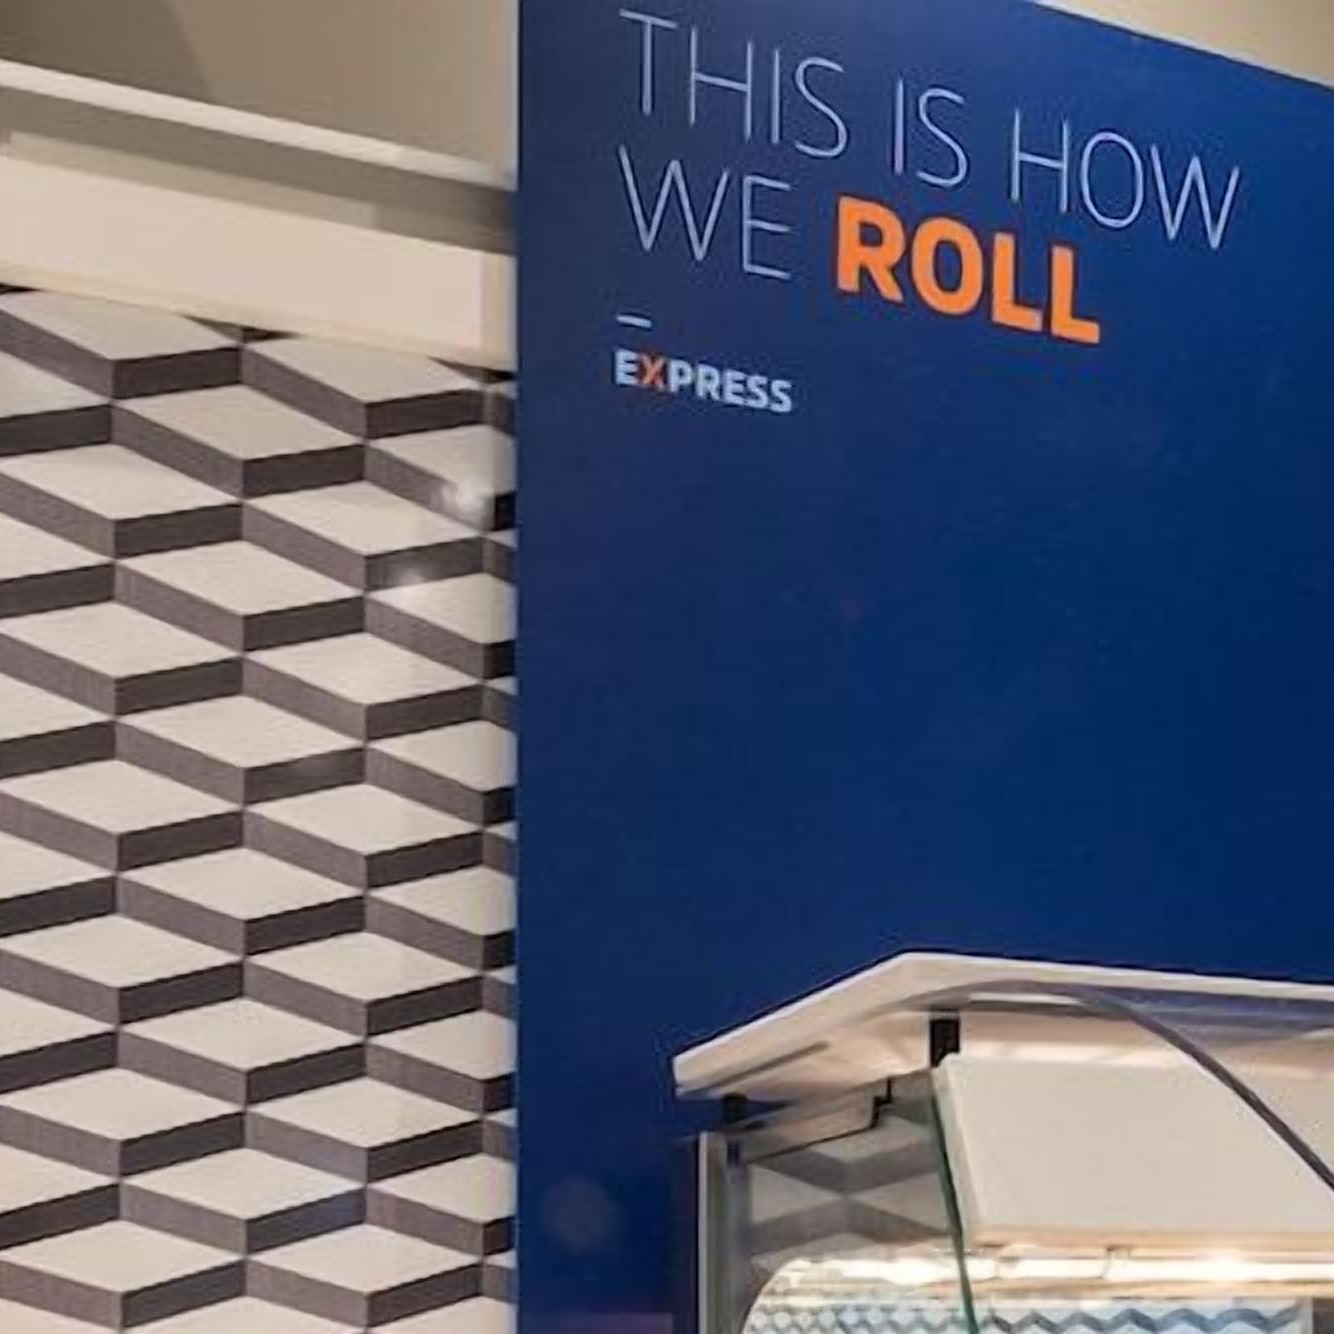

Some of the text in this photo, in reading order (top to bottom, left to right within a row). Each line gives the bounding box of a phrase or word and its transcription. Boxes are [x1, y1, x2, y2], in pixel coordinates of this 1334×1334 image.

[618, 8, 1242, 251] THIS IS HOW
[618, 143, 1102, 345] WE ROLL
[614, 348, 792, 413] EXPRESS
